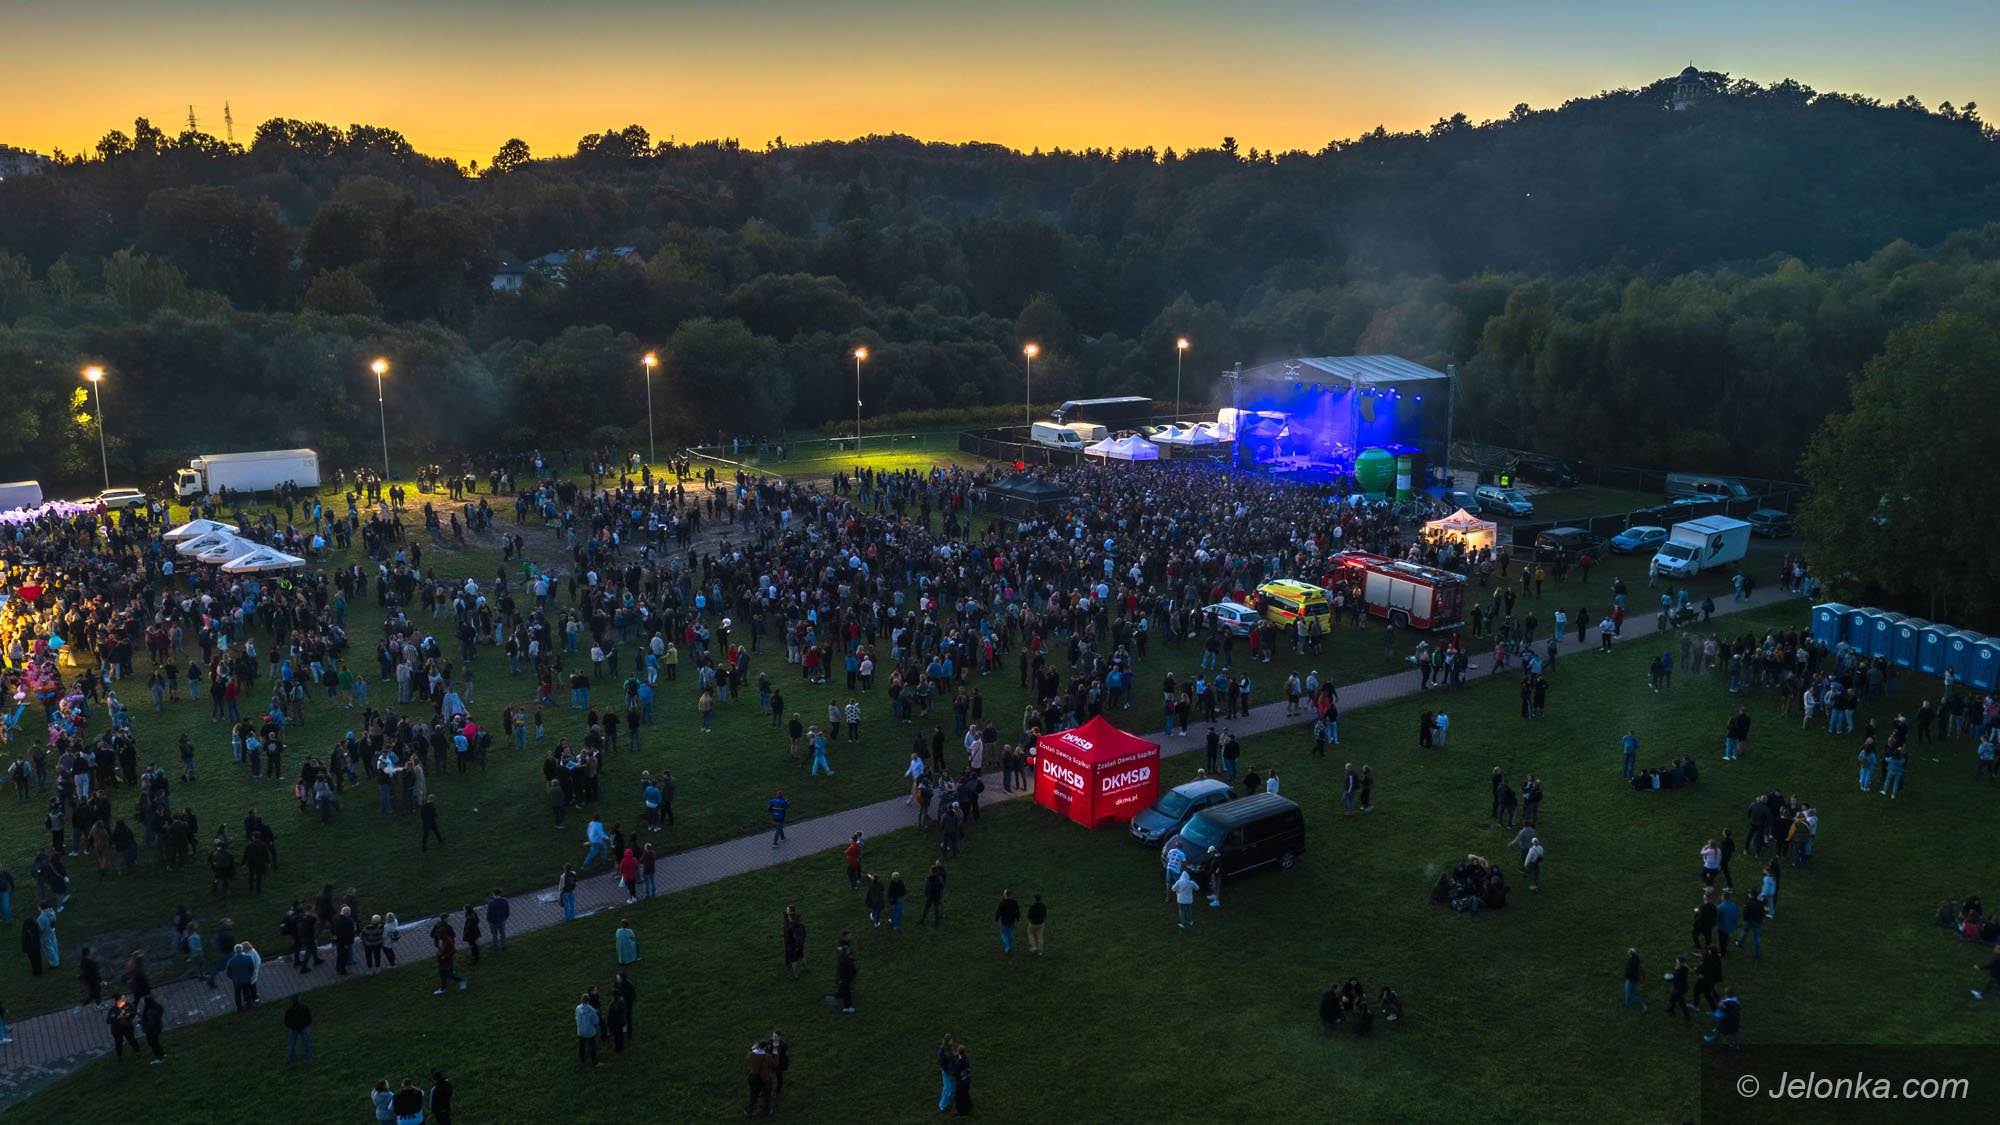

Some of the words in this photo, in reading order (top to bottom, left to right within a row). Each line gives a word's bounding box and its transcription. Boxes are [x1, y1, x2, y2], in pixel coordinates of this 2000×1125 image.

[1062, 733, 1086, 746] DKMS
[1097, 760, 1116, 770] Zostań
[1117, 754, 1136, 765] Dawcą
[1043, 759, 1074, 785] DKMS
[1102, 769, 1139, 792] DKMS
[1115, 793, 1138, 806] dkms.pl
